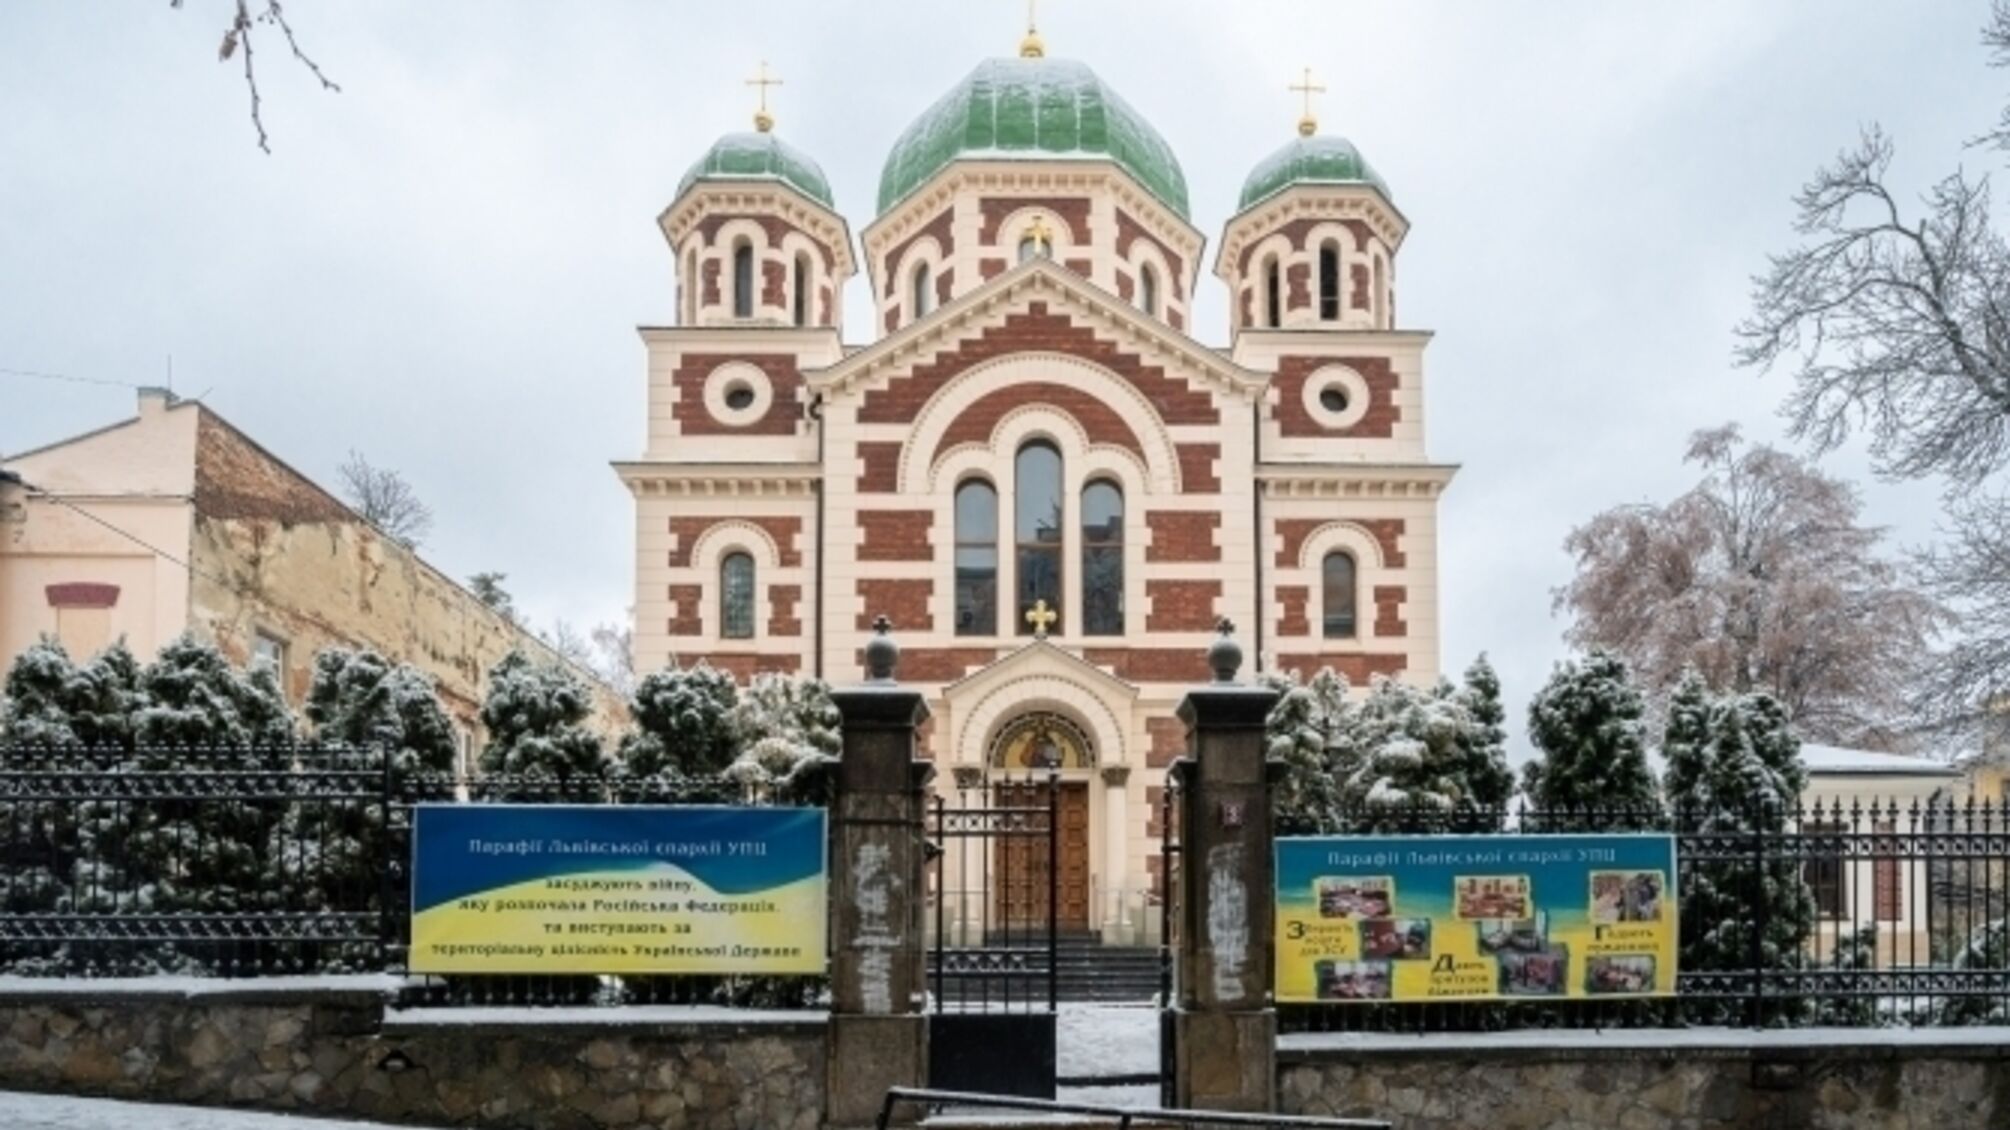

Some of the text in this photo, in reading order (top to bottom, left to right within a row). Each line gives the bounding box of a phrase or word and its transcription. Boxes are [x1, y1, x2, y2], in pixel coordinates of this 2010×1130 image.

[469, 839, 767, 857] Парафії Львівської єпархії УПЦ
[1328, 850, 1399, 868] Парафії
[1406, 849, 1501, 866] Львівської
[459, 901, 489, 913] яку
[593, 900, 679, 913] Російська
[543, 923, 692, 936] та виступають за
